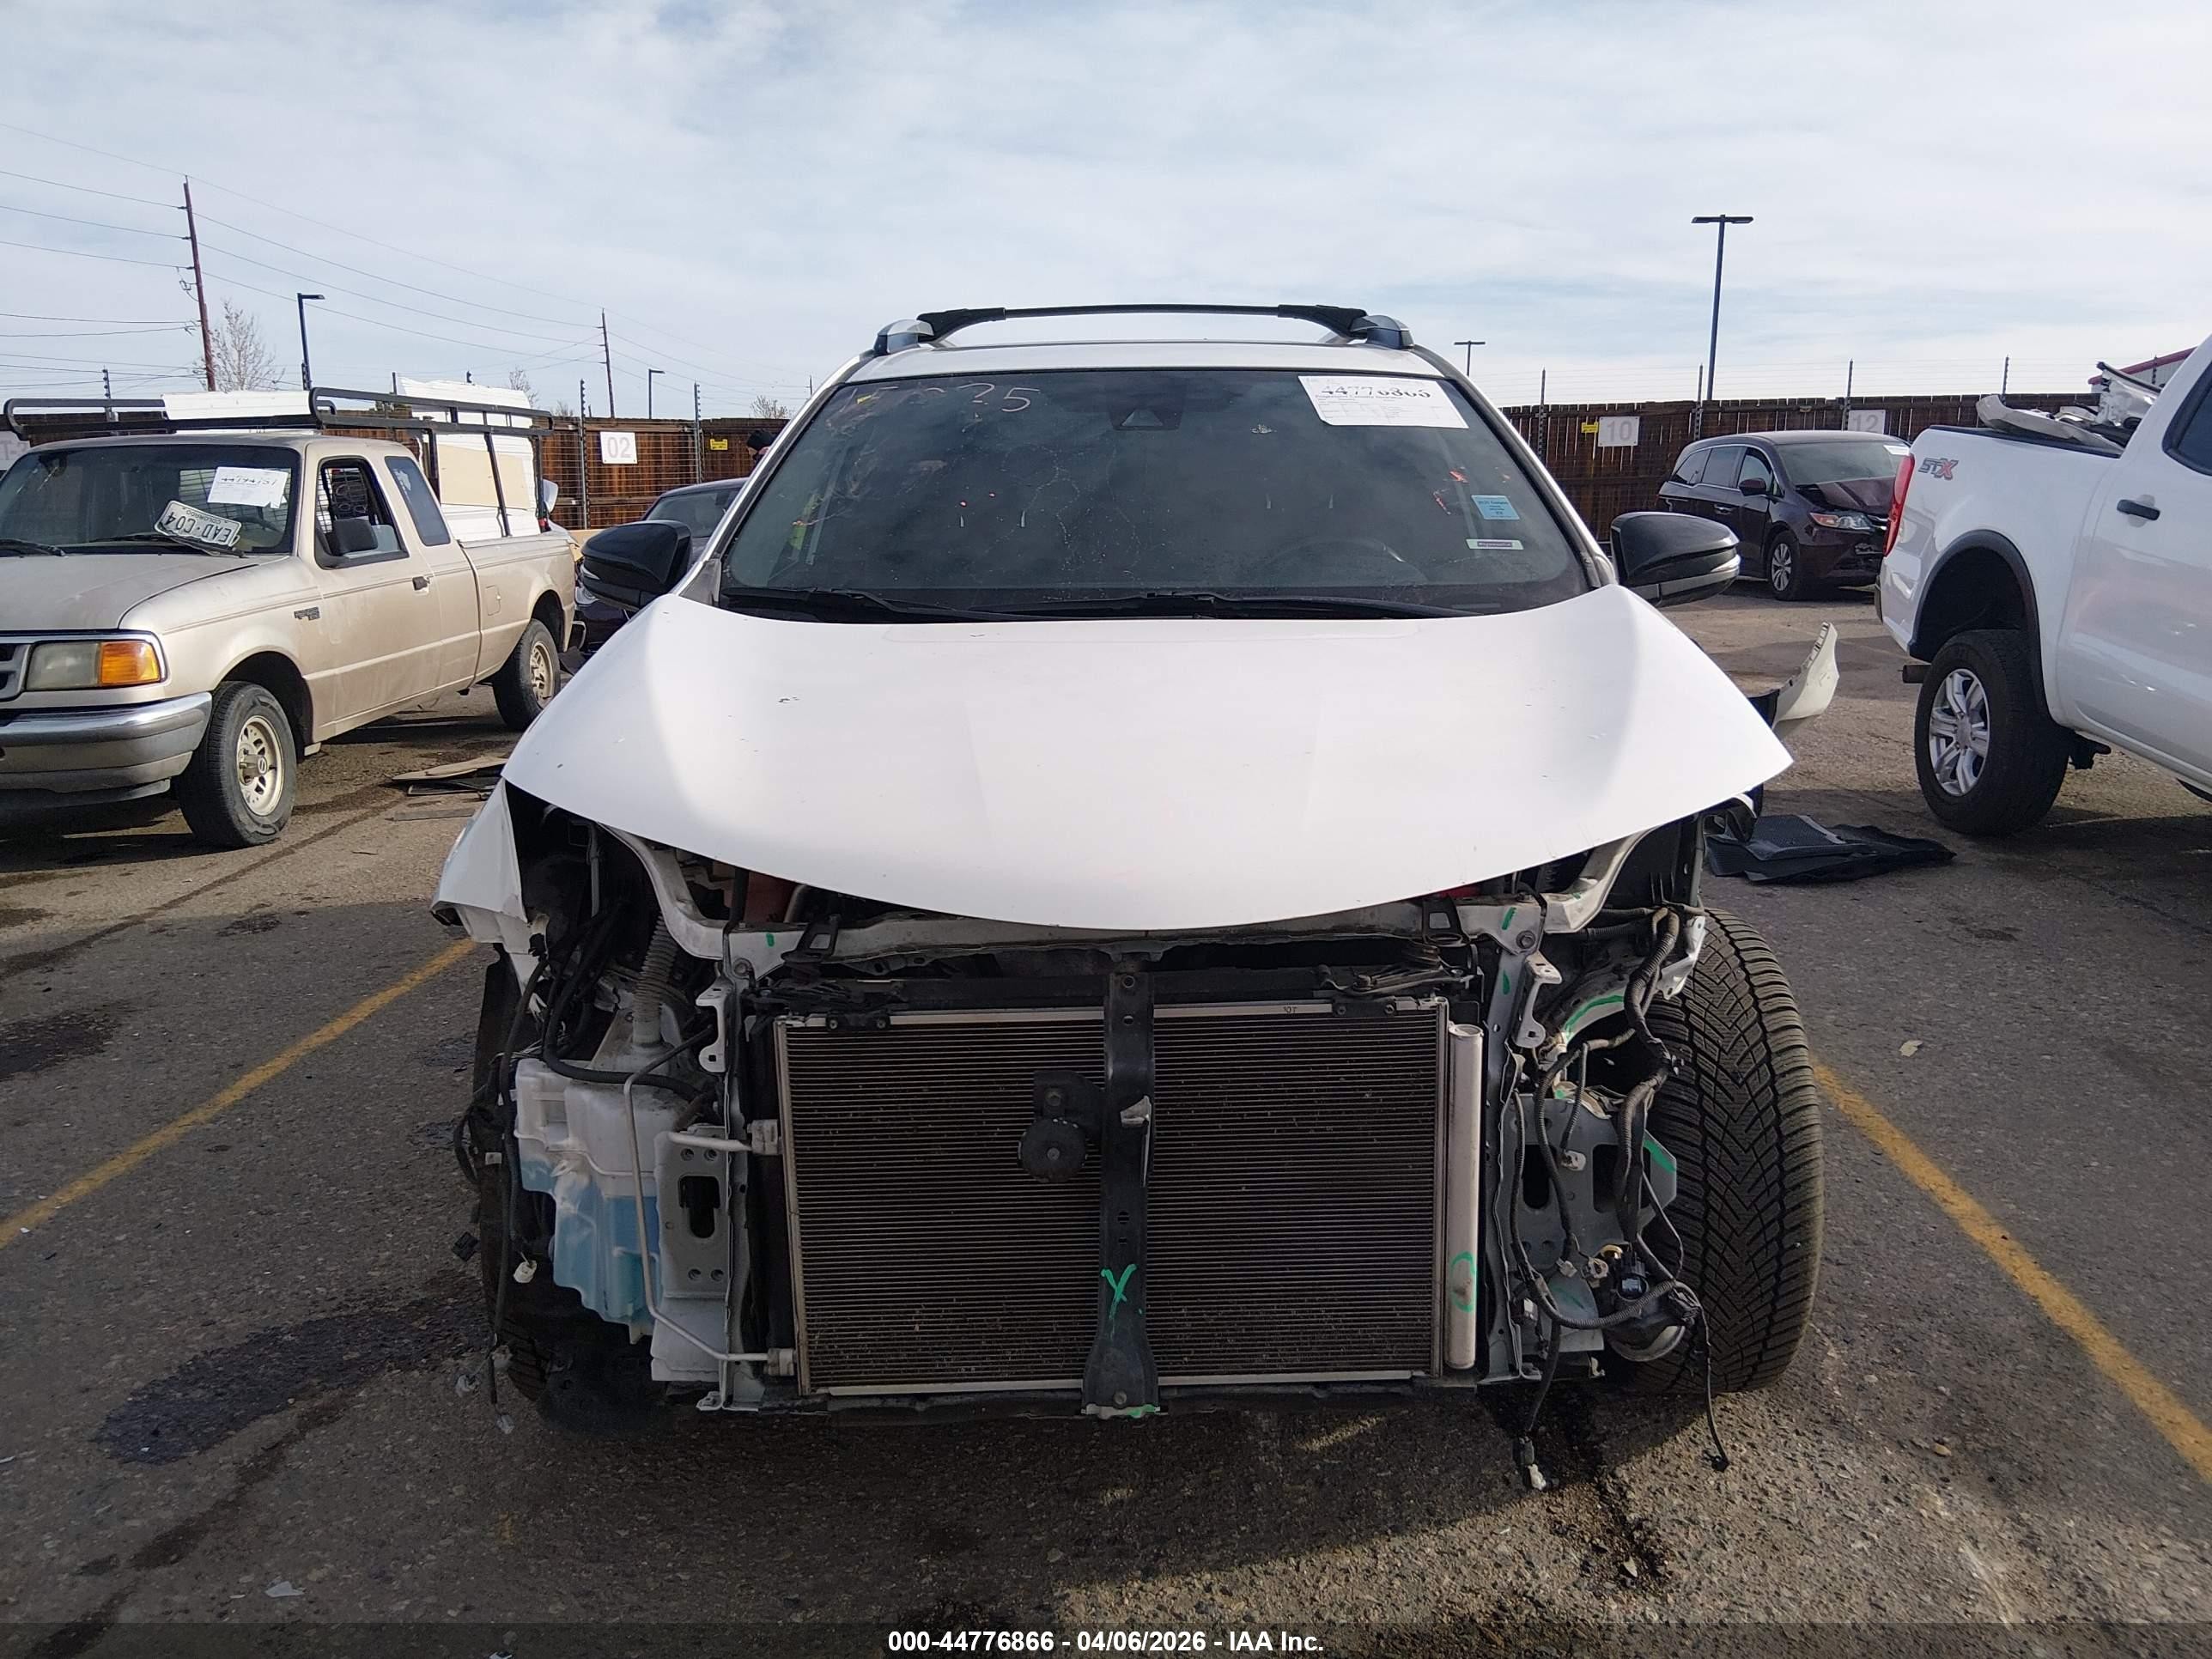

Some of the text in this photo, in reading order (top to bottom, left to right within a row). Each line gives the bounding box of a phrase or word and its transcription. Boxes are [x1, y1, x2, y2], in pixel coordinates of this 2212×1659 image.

[1607, 420, 1632, 442] 10
[1853, 415, 1879, 432] 12
[608, 436, 631, 459] 02
[1917, 457, 1960, 481] STX
